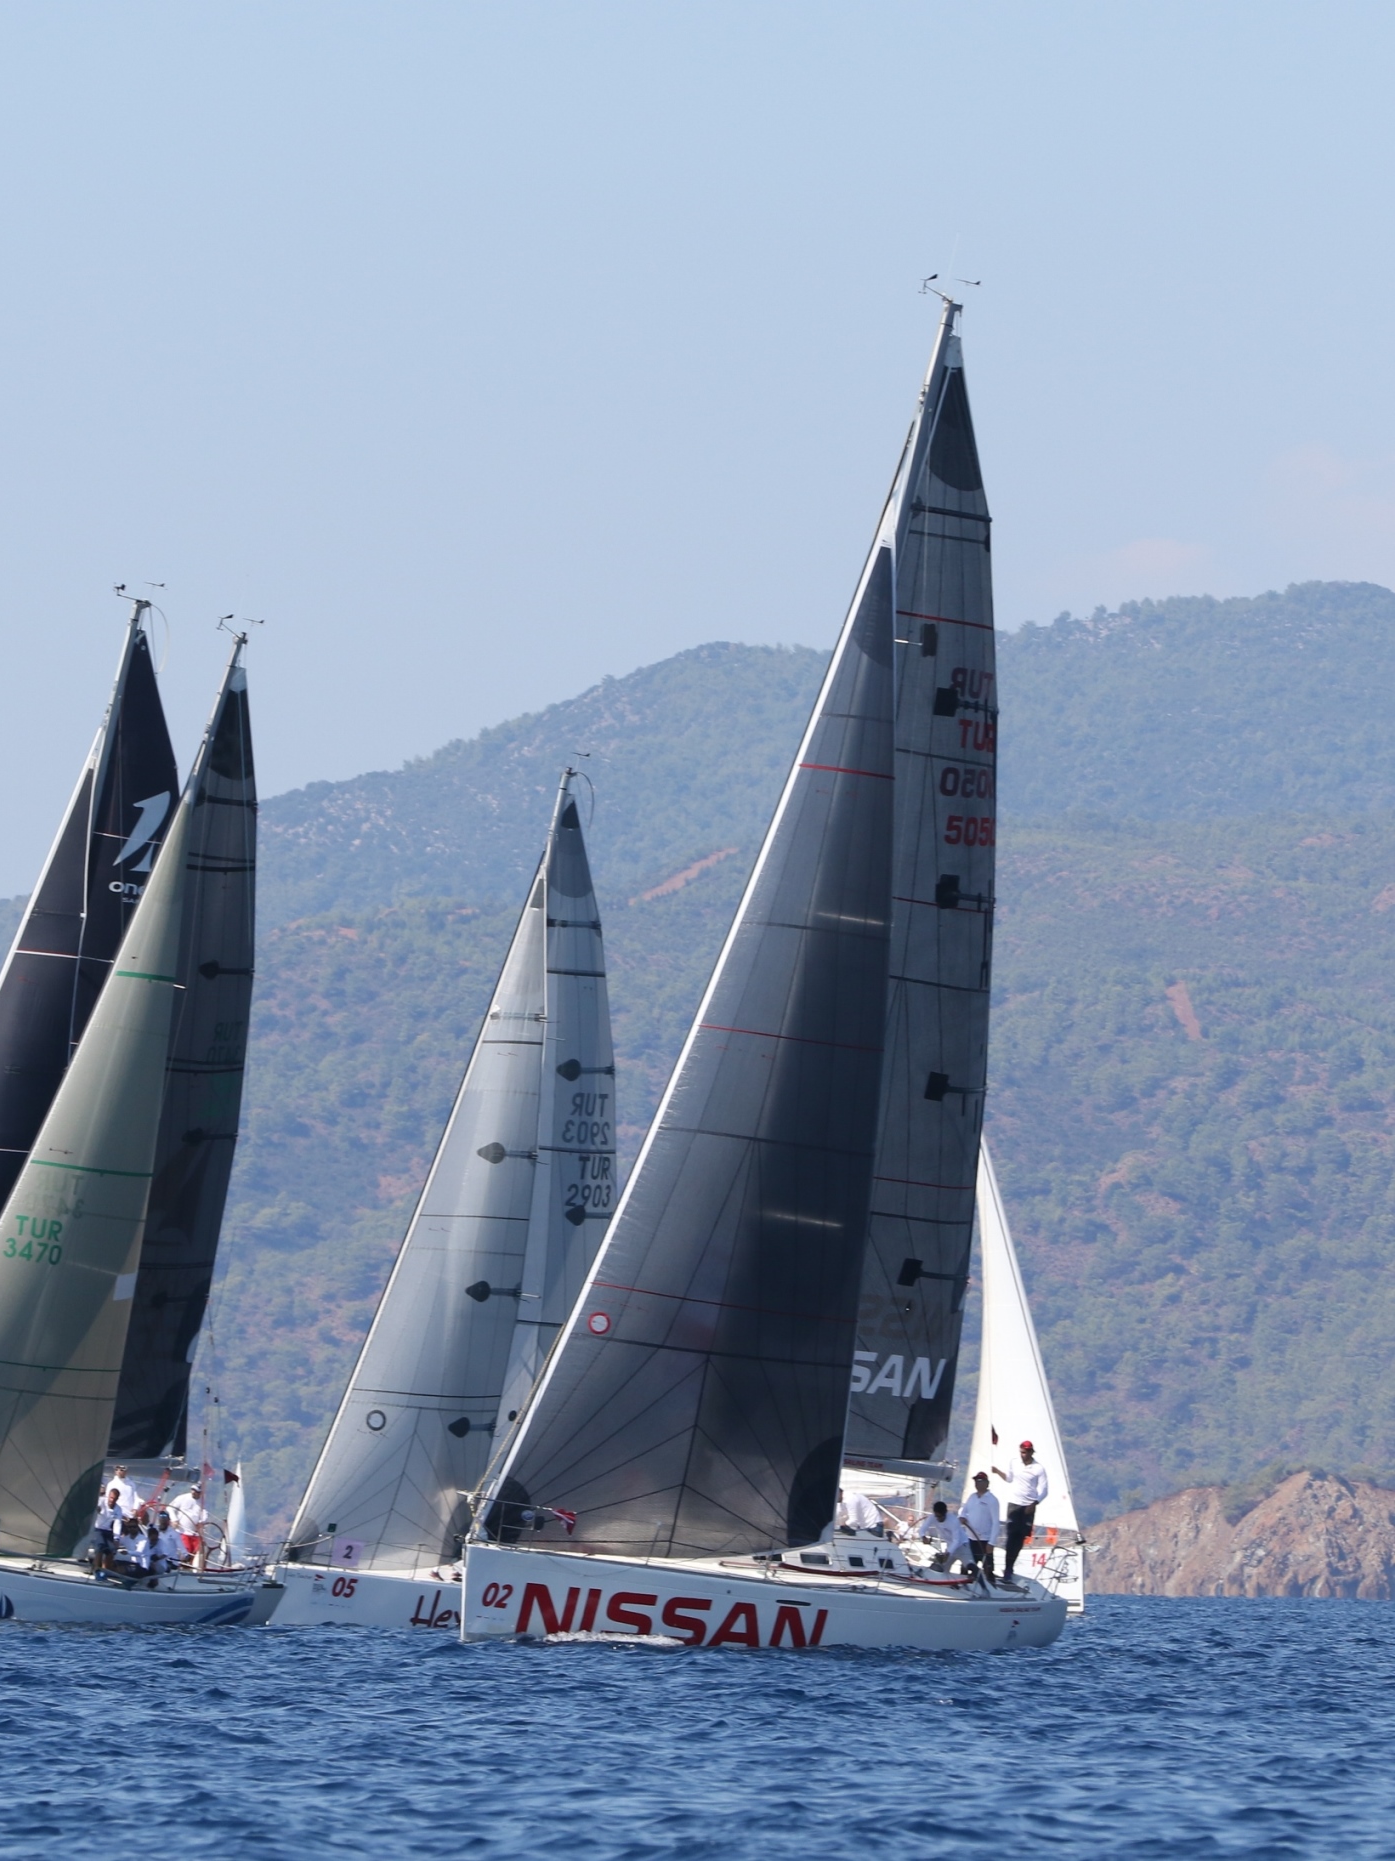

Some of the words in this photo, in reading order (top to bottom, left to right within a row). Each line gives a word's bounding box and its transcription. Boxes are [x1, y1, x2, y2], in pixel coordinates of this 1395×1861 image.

[578, 1155, 611, 1180] TUR
[565, 1184, 612, 1208] 2903
[15, 1215, 63, 1241] TUR
[3, 1237, 63, 1265] 3470
[343, 1545, 354, 1559] 2
[1031, 1553, 1047, 1567] 14
[332, 1577, 359, 1598] 05
[482, 1582, 513, 1609] 02
[515, 1582, 828, 1648] NISSAN
